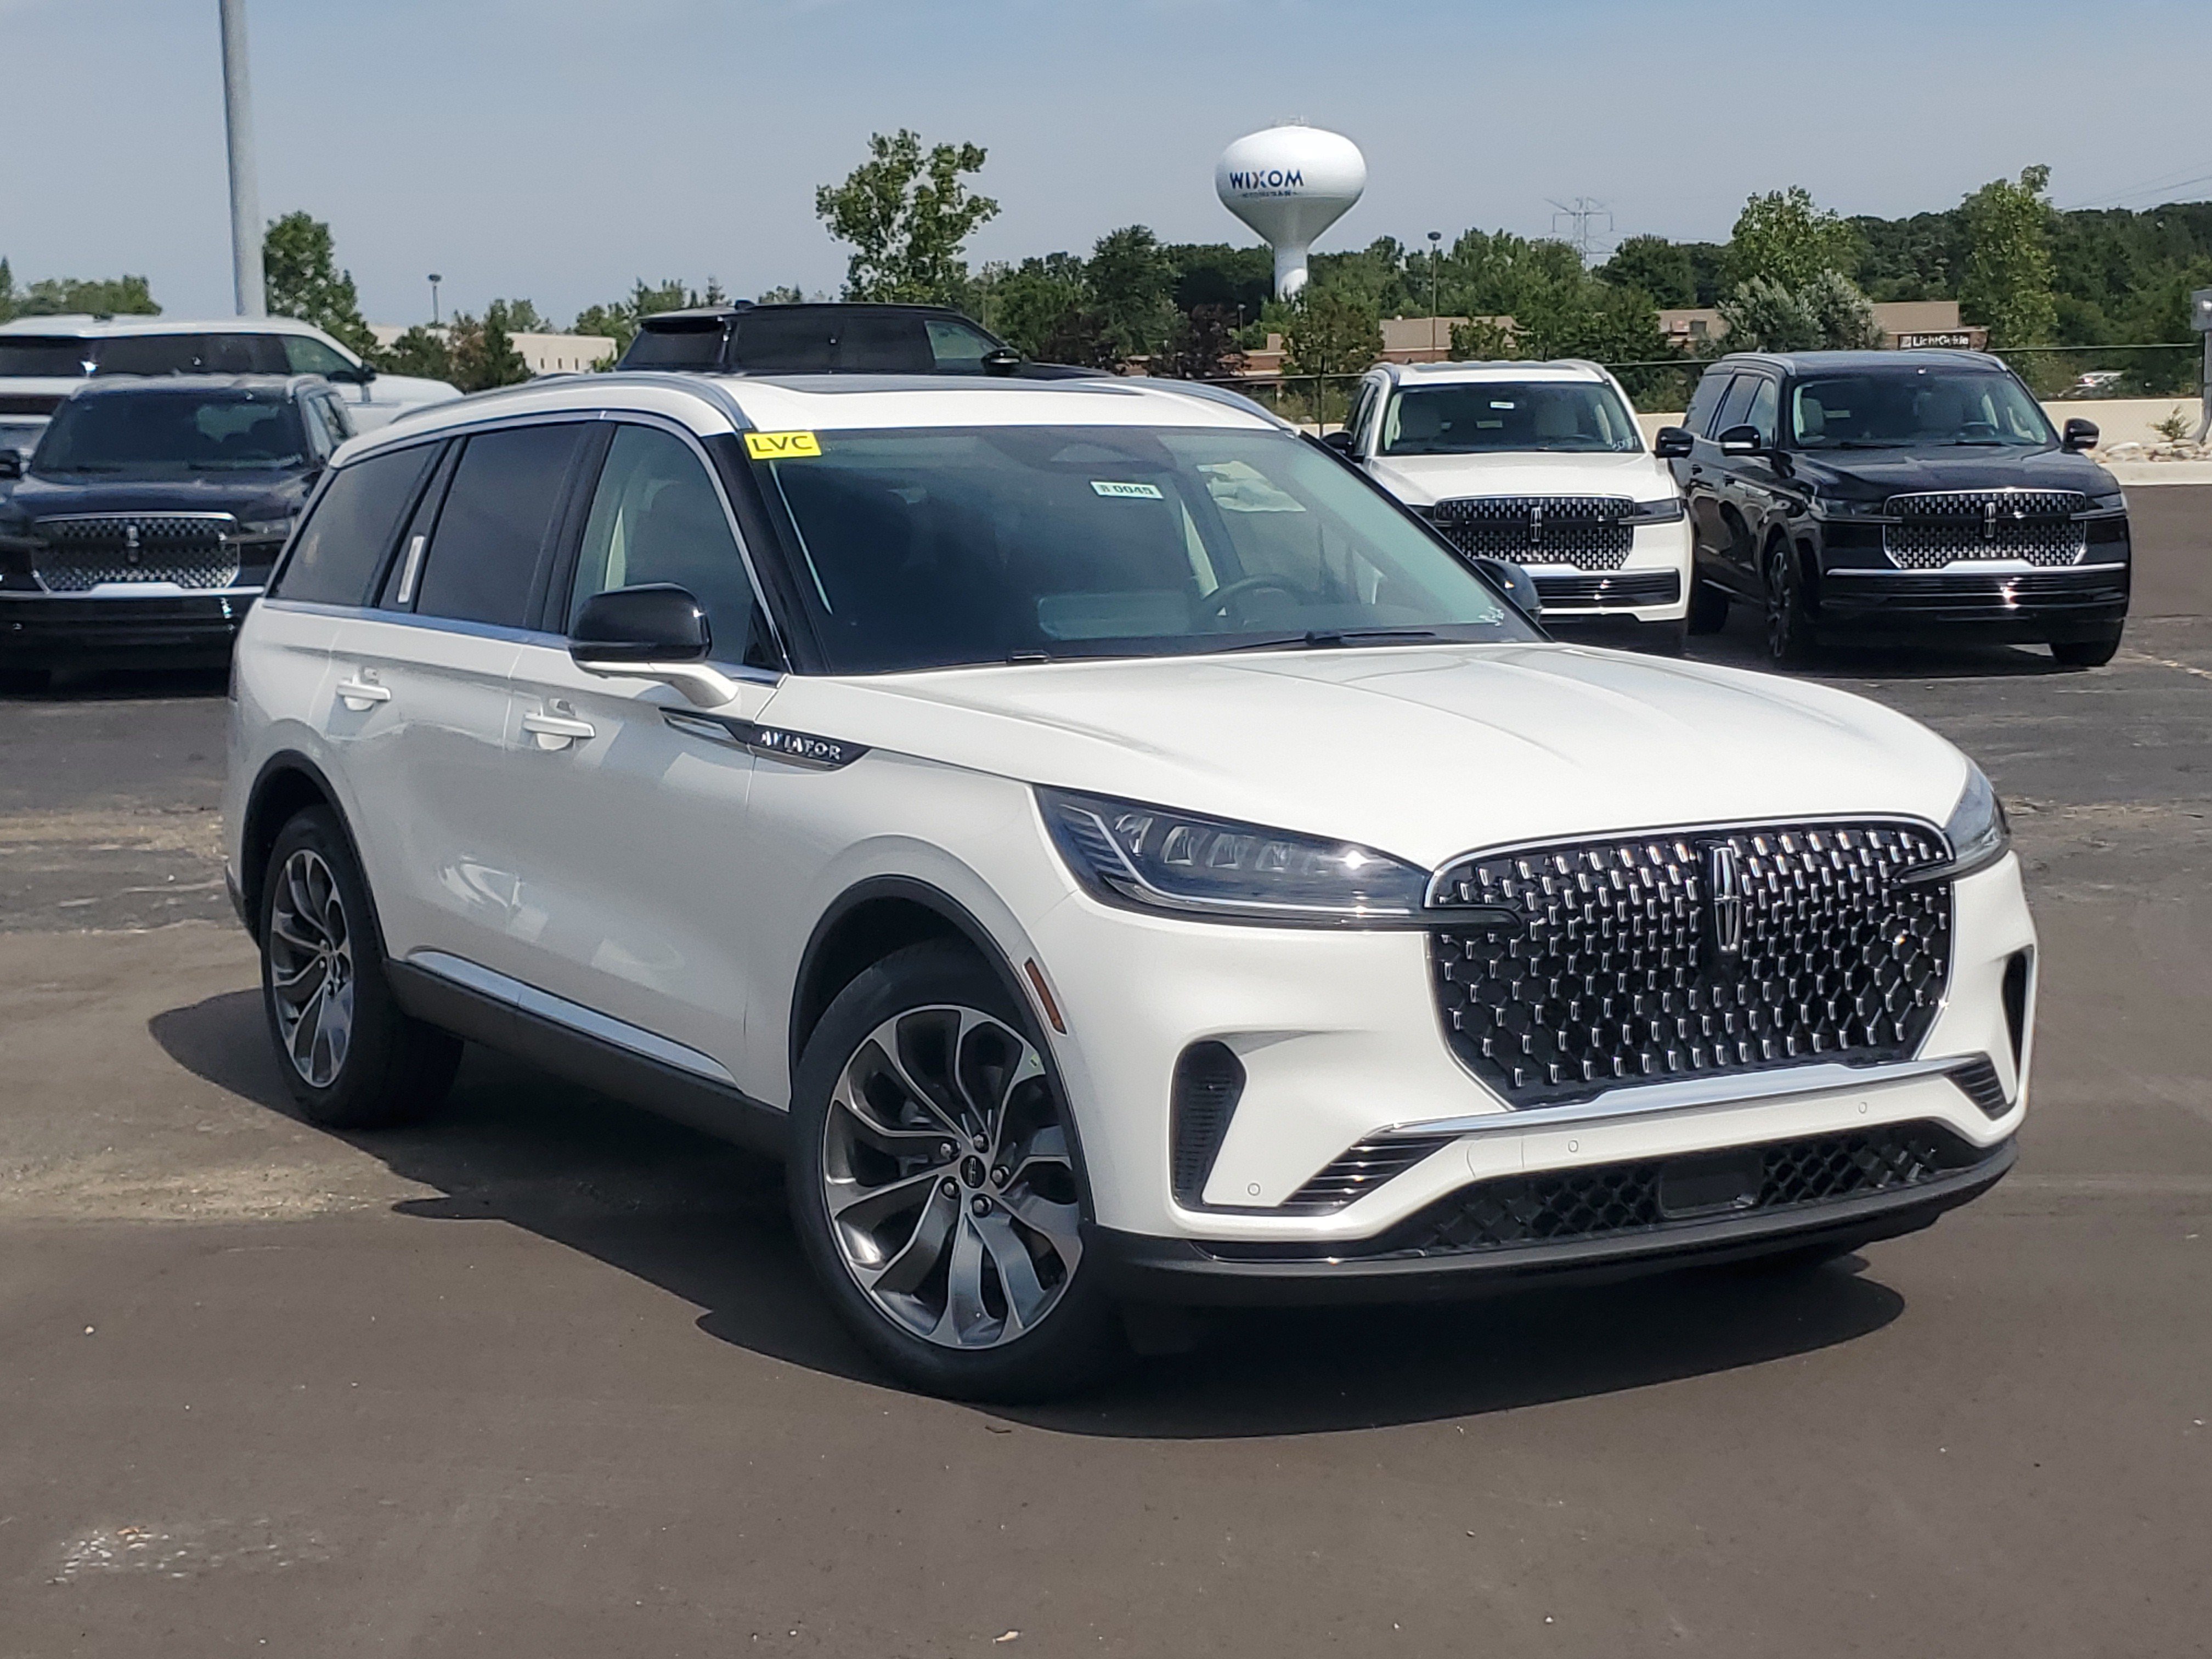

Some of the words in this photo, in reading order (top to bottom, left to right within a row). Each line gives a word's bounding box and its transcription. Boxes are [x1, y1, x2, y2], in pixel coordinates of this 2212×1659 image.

[1229, 169, 1304, 189] WIXOM
[752, 435, 812, 452] LVC
[760, 730, 842, 760] AVIATOR
